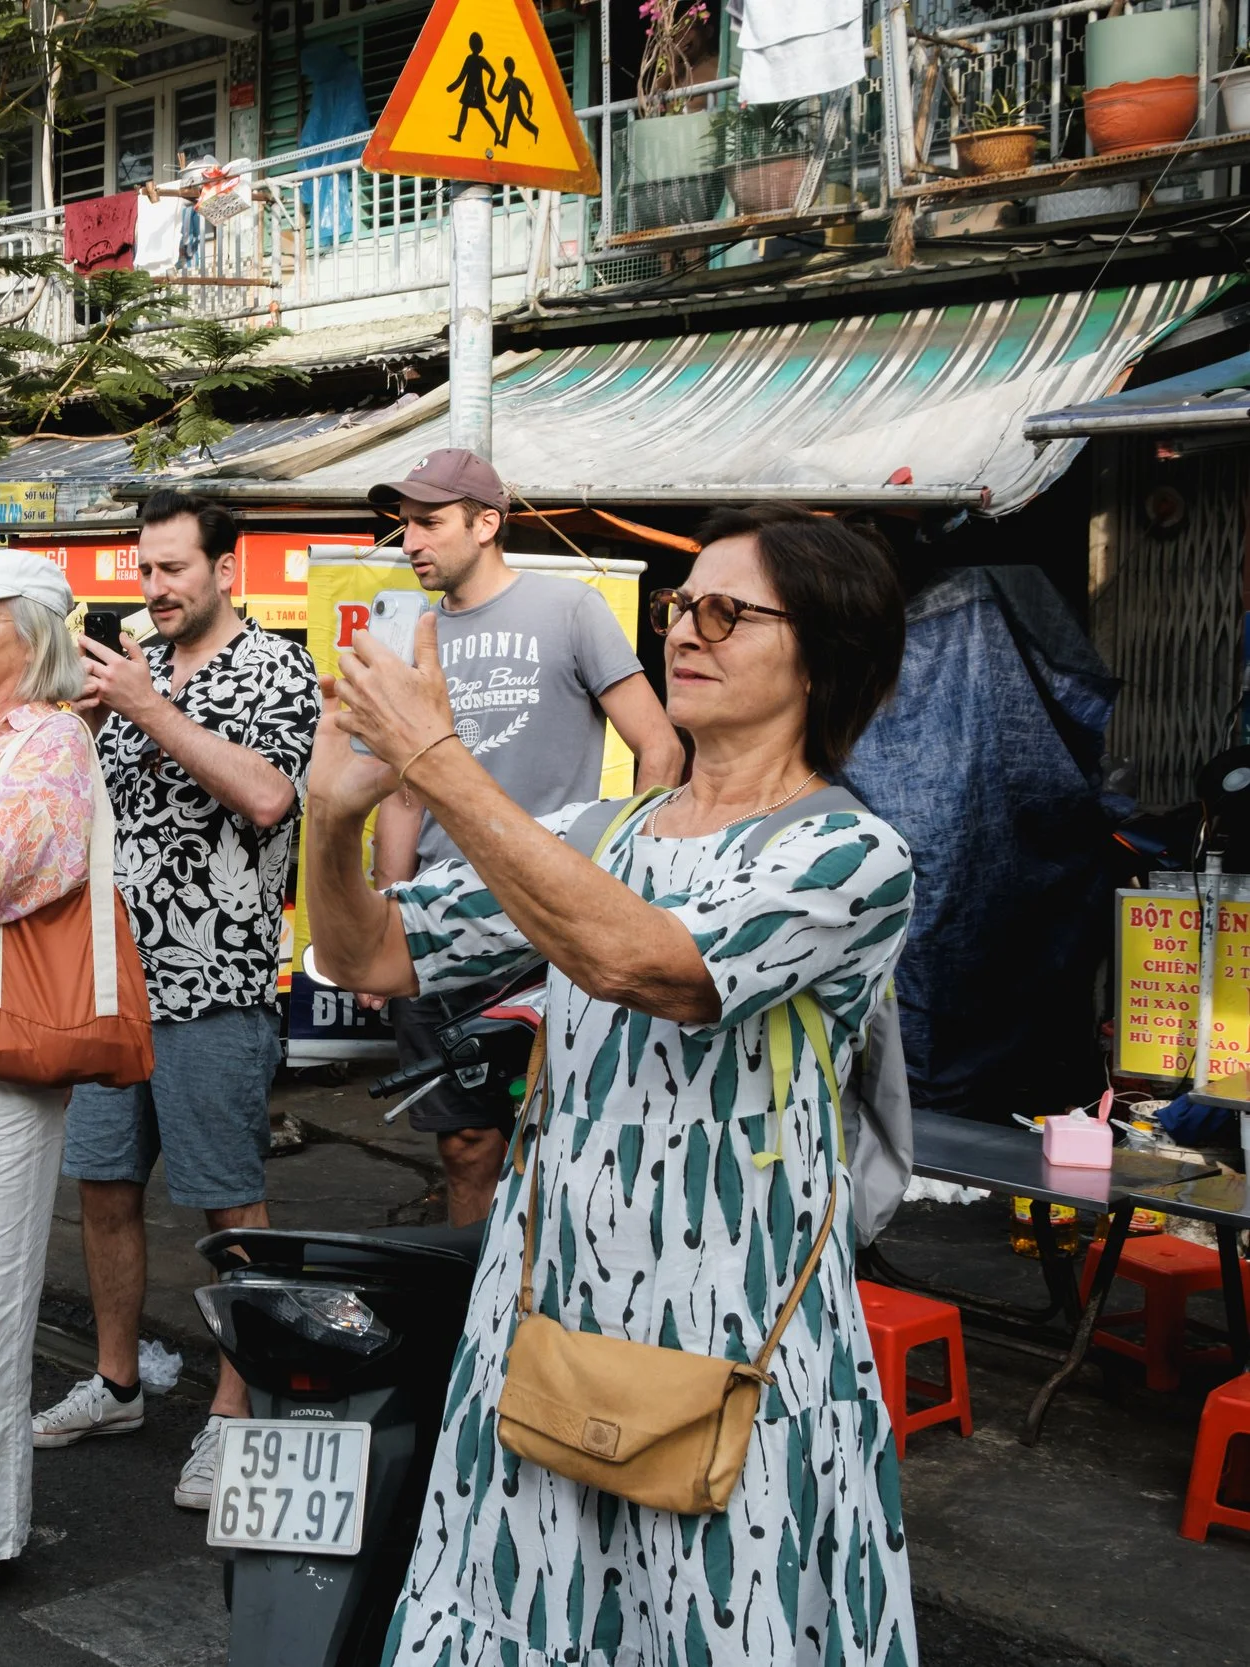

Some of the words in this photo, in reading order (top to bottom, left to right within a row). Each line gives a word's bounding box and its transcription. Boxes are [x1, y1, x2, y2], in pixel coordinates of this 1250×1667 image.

[116, 570, 138, 581] KEBAB
[276, 610, 296, 621] TAM
[298, 610, 308, 621] GI
[442, 631, 540, 668] IFORNIA
[488, 667, 541, 689] Bowl
[1129, 902, 1174, 932] BỘT
[1153, 935, 1189, 954] BỘT
[1226, 944, 1234, 957] 1
[1142, 958, 1198, 975] CHIÊN
[1224, 966, 1235, 978] 2
[1130, 979, 1160, 992] NUI
[311, 990, 366, 1026] ĐT.
[1188, 1019, 1225, 1033] XO
[289, 1409, 335, 1419] HONDA
[240, 1429, 342, 1483] 59-U1
[220, 1485, 355, 1544] 657.97
